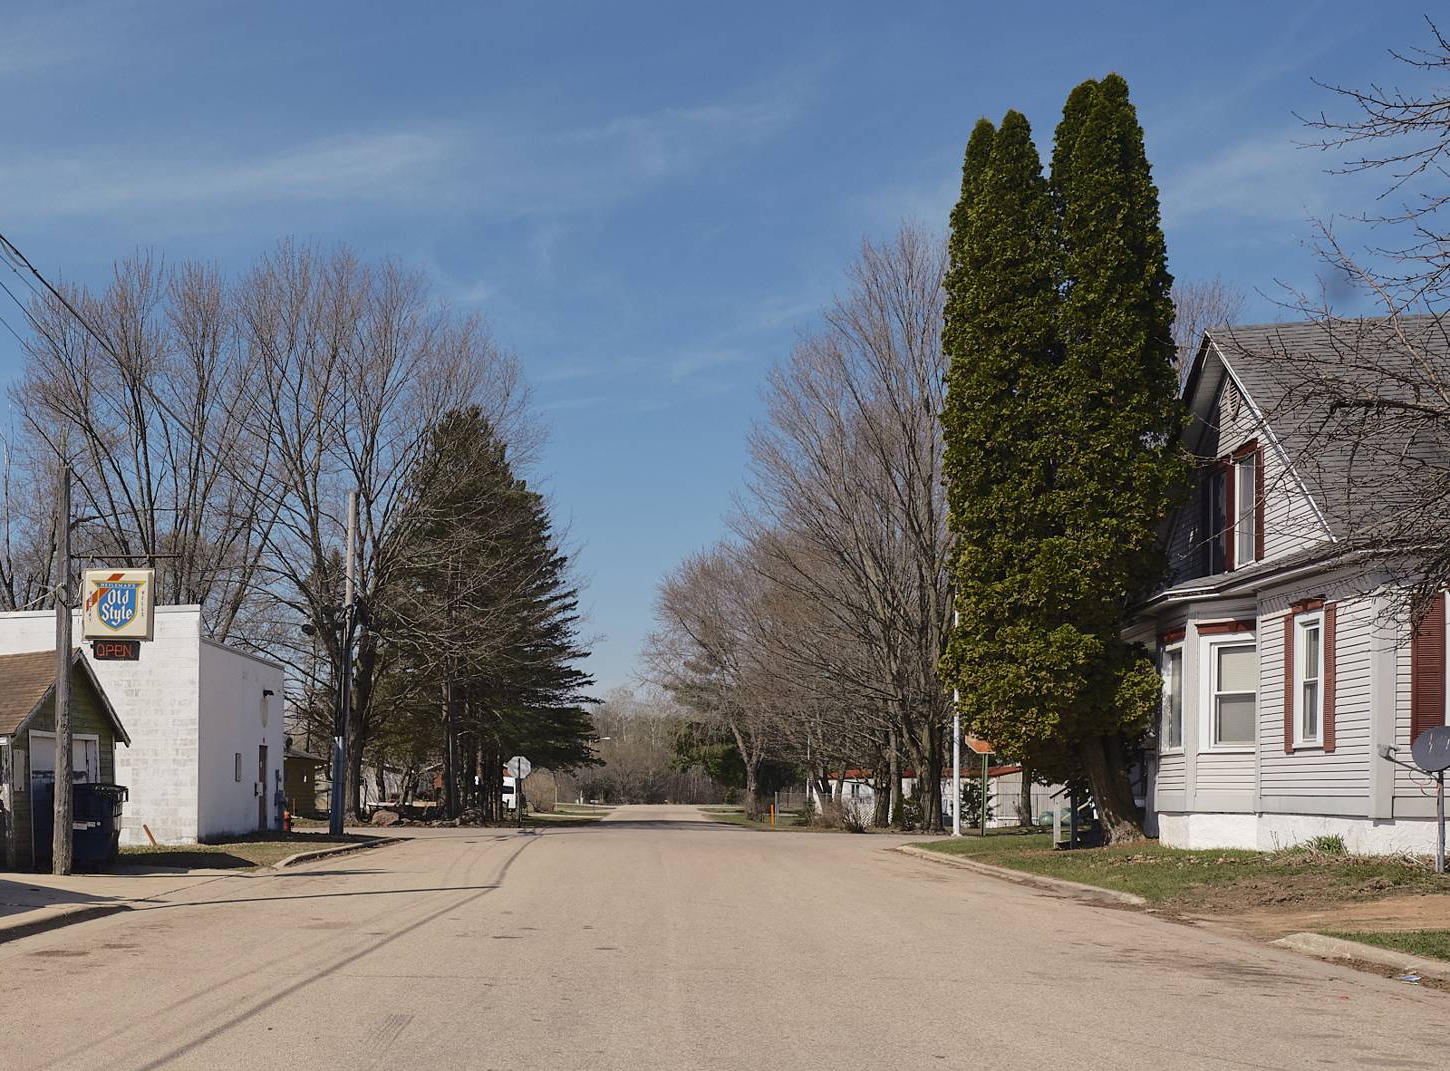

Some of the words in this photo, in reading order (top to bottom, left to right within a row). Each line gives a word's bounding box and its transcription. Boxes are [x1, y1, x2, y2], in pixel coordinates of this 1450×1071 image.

[108, 588, 129, 605] Old
[101, 603, 133, 626] Style
[97, 644, 132, 657] OPEN
